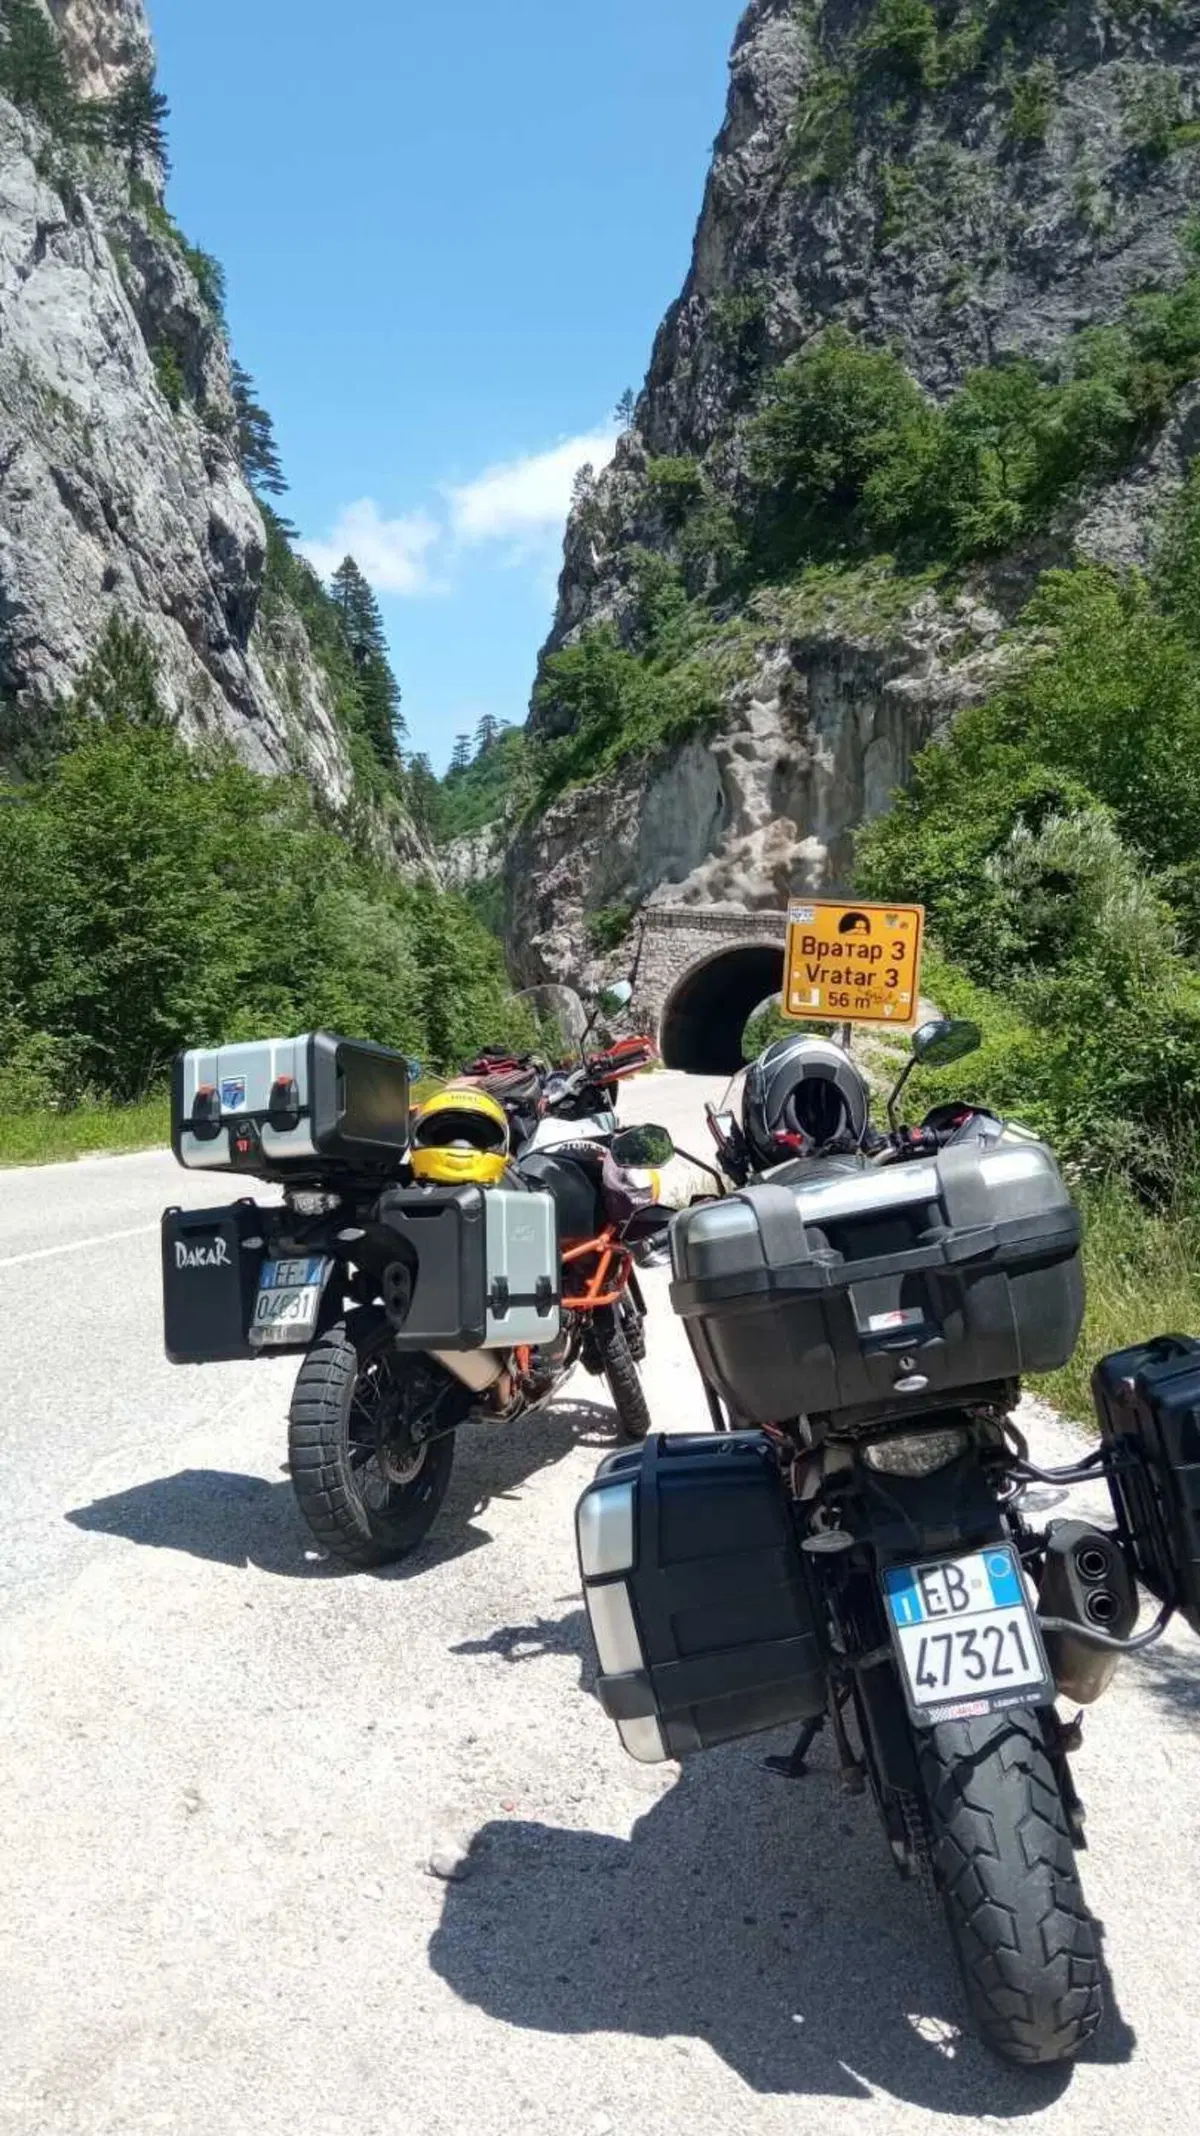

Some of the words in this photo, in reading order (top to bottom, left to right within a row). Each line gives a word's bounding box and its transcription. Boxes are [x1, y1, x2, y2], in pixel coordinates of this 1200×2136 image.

[801, 935, 882, 965] Вратар
[891, 940, 906, 961] 3
[805, 963, 877, 986] Vratar
[884, 967, 899, 988] 3
[828, 991, 849, 1008] 56
[855, 998, 870, 1009] m
[917, 1563, 970, 1617] EB
[916, 1620, 1030, 1688] 47321
